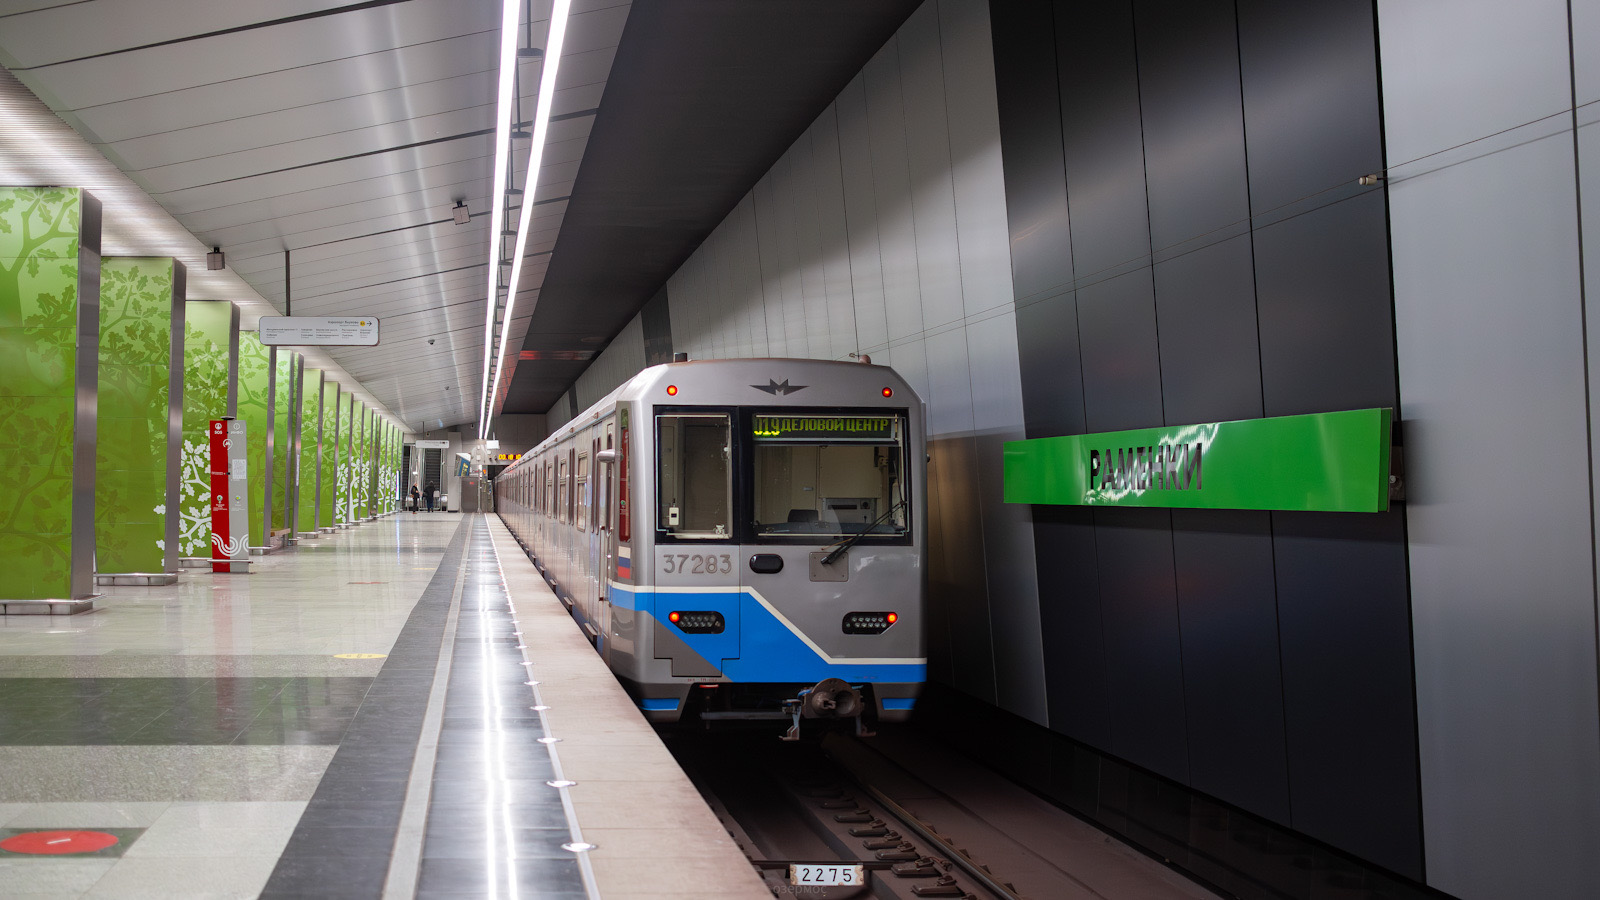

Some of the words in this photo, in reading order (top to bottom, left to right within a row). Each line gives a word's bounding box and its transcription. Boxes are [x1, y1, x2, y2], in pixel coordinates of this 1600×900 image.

[780, 418, 844, 432] ДЕЛОВОЙ
[846, 418, 889, 432] ЦЕНТР
[1090, 443, 1202, 490] РАМЕНКИ
[663, 554, 732, 574] 37283
[802, 868, 852, 882] 2275
